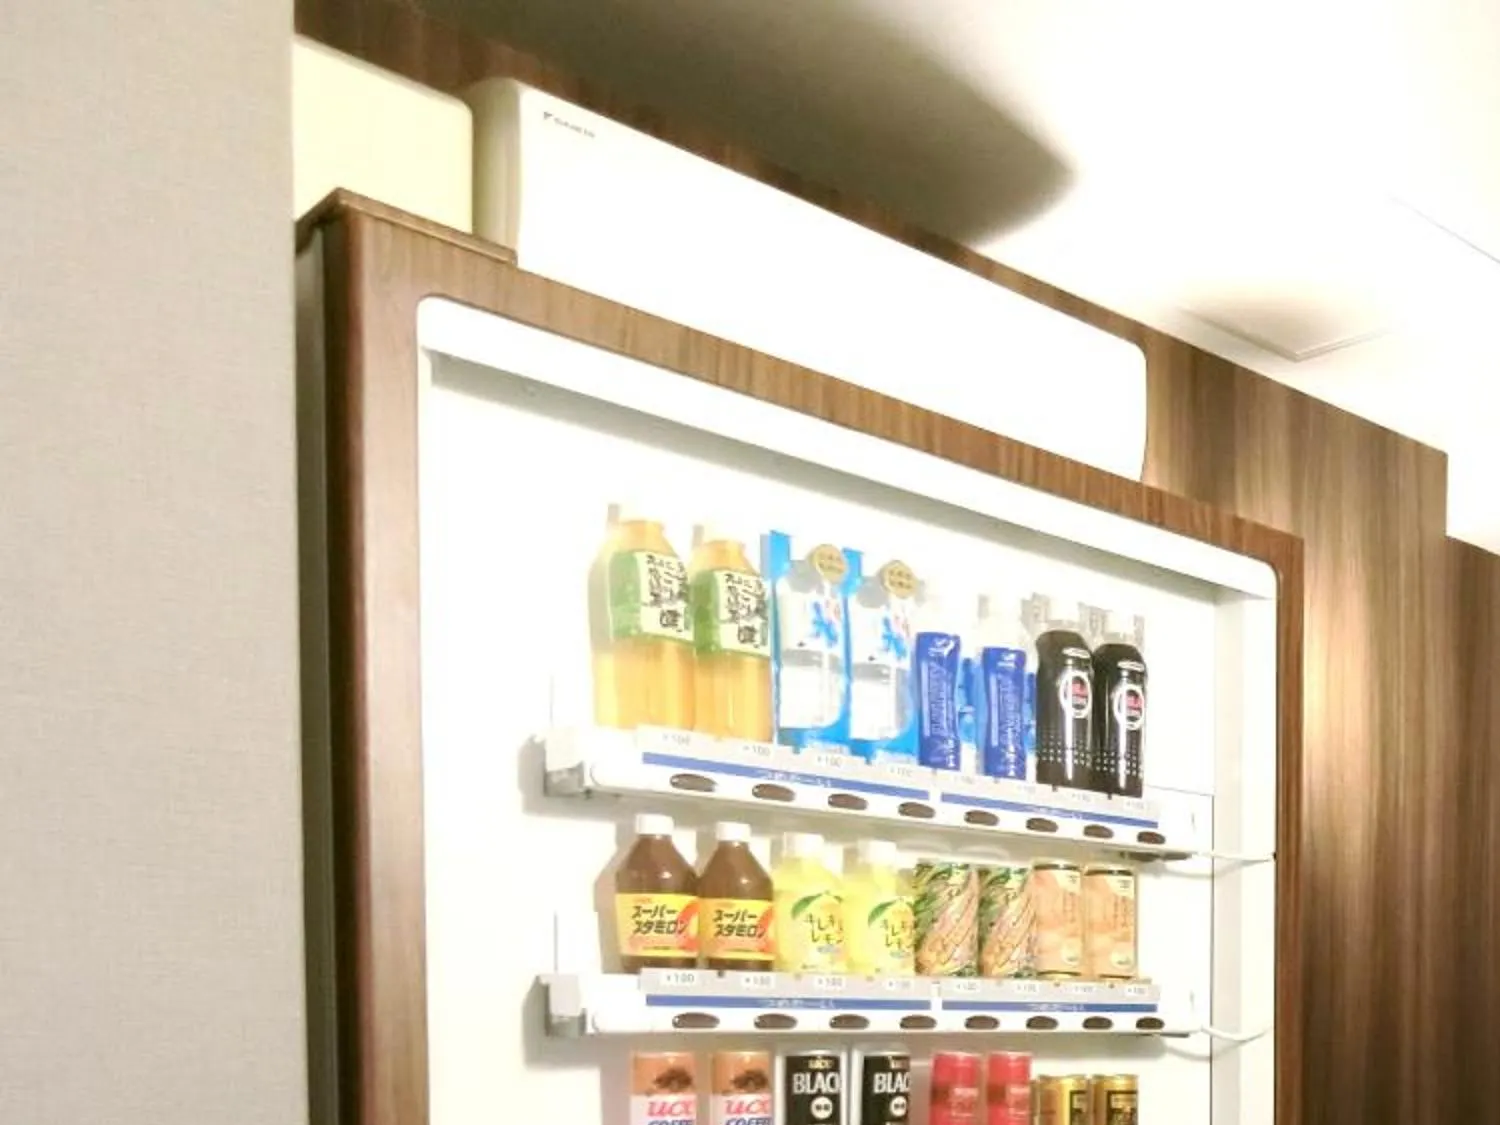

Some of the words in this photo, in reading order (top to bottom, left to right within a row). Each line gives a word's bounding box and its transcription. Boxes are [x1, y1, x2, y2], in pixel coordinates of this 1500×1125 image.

[631, 905, 678, 919] スーパー
[712, 909, 757, 924] スーパー
[633, 920, 687, 936] スタミロン
[714, 923, 767, 938] スタミロン
